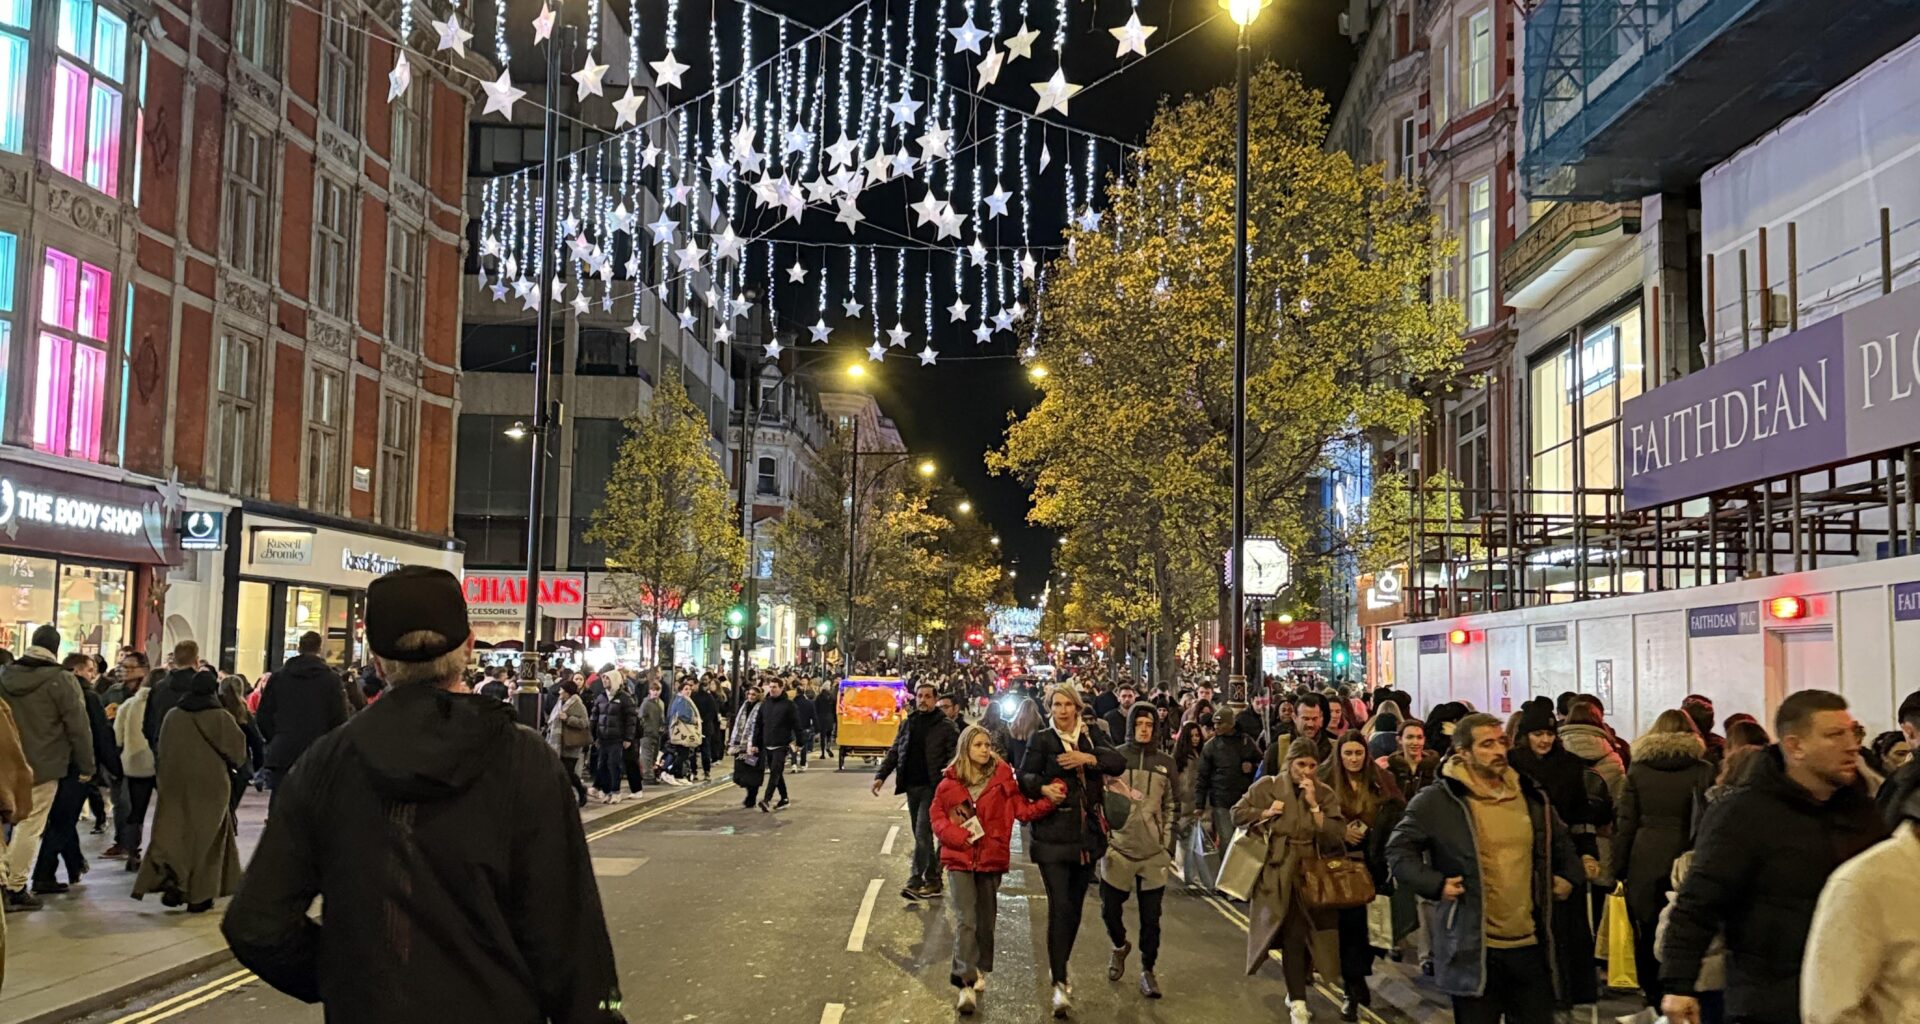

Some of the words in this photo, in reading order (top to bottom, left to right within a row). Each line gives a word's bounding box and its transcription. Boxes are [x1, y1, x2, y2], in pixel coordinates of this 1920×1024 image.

[1631, 358, 1828, 477] FAITHDEAN
[17, 490, 53, 522] THE
[55, 497, 100, 529] BODY
[100, 505, 143, 535] SHOP
[267, 538, 301, 549] Russell
[467, 607, 518, 615] CCESSORIES
[1690, 613, 1736, 630] FAITHDEAN
[1740, 611, 1756, 626] PLC
